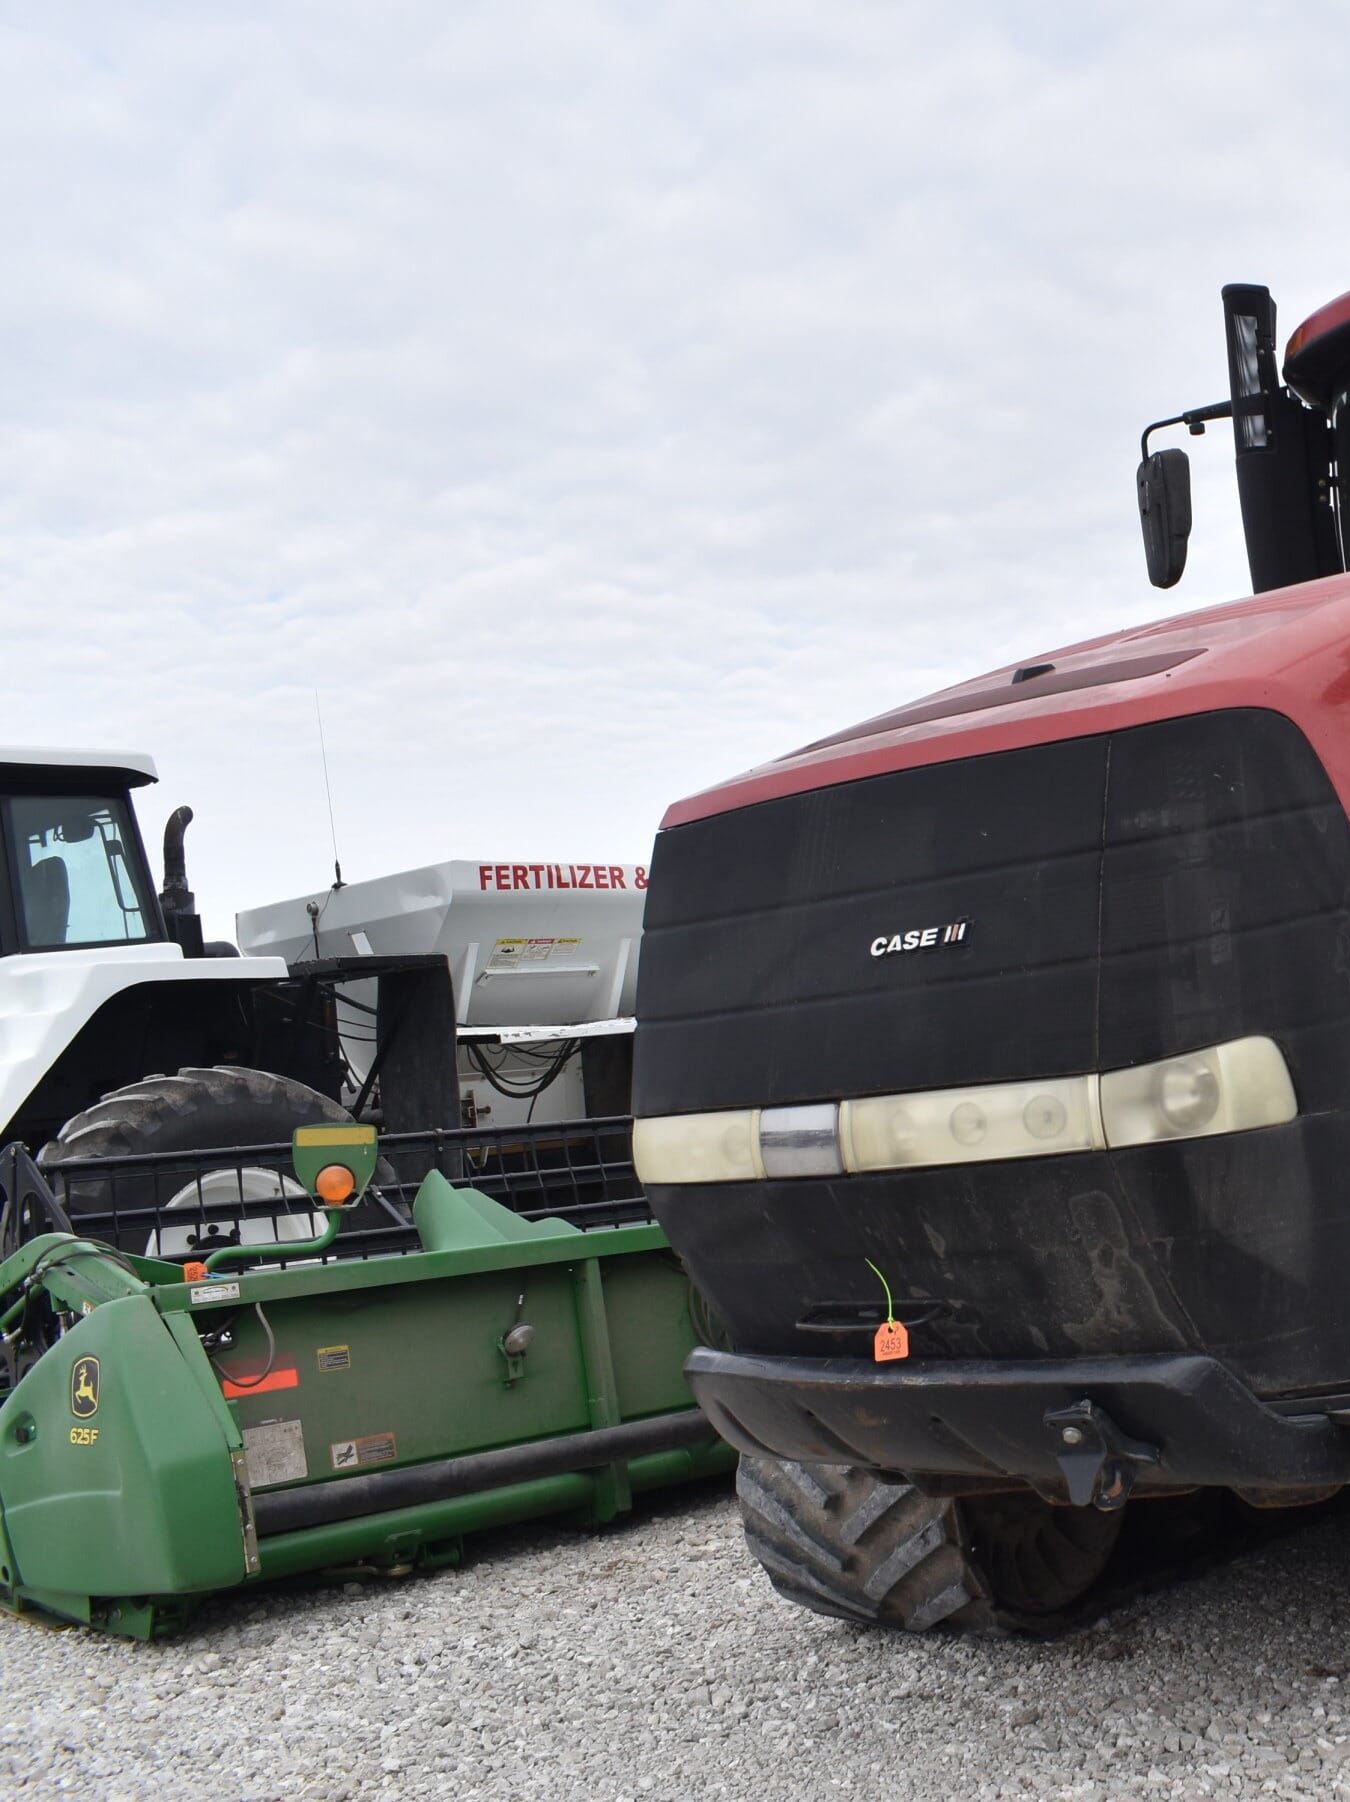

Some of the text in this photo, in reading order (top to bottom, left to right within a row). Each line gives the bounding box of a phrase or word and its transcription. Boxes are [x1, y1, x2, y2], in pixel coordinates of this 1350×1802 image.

[479, 864, 649, 891] FERTILIZER &
[870, 928, 939, 957] CASE
[880, 1337, 902, 1353] 2453
[70, 1427, 99, 1446] 625F
